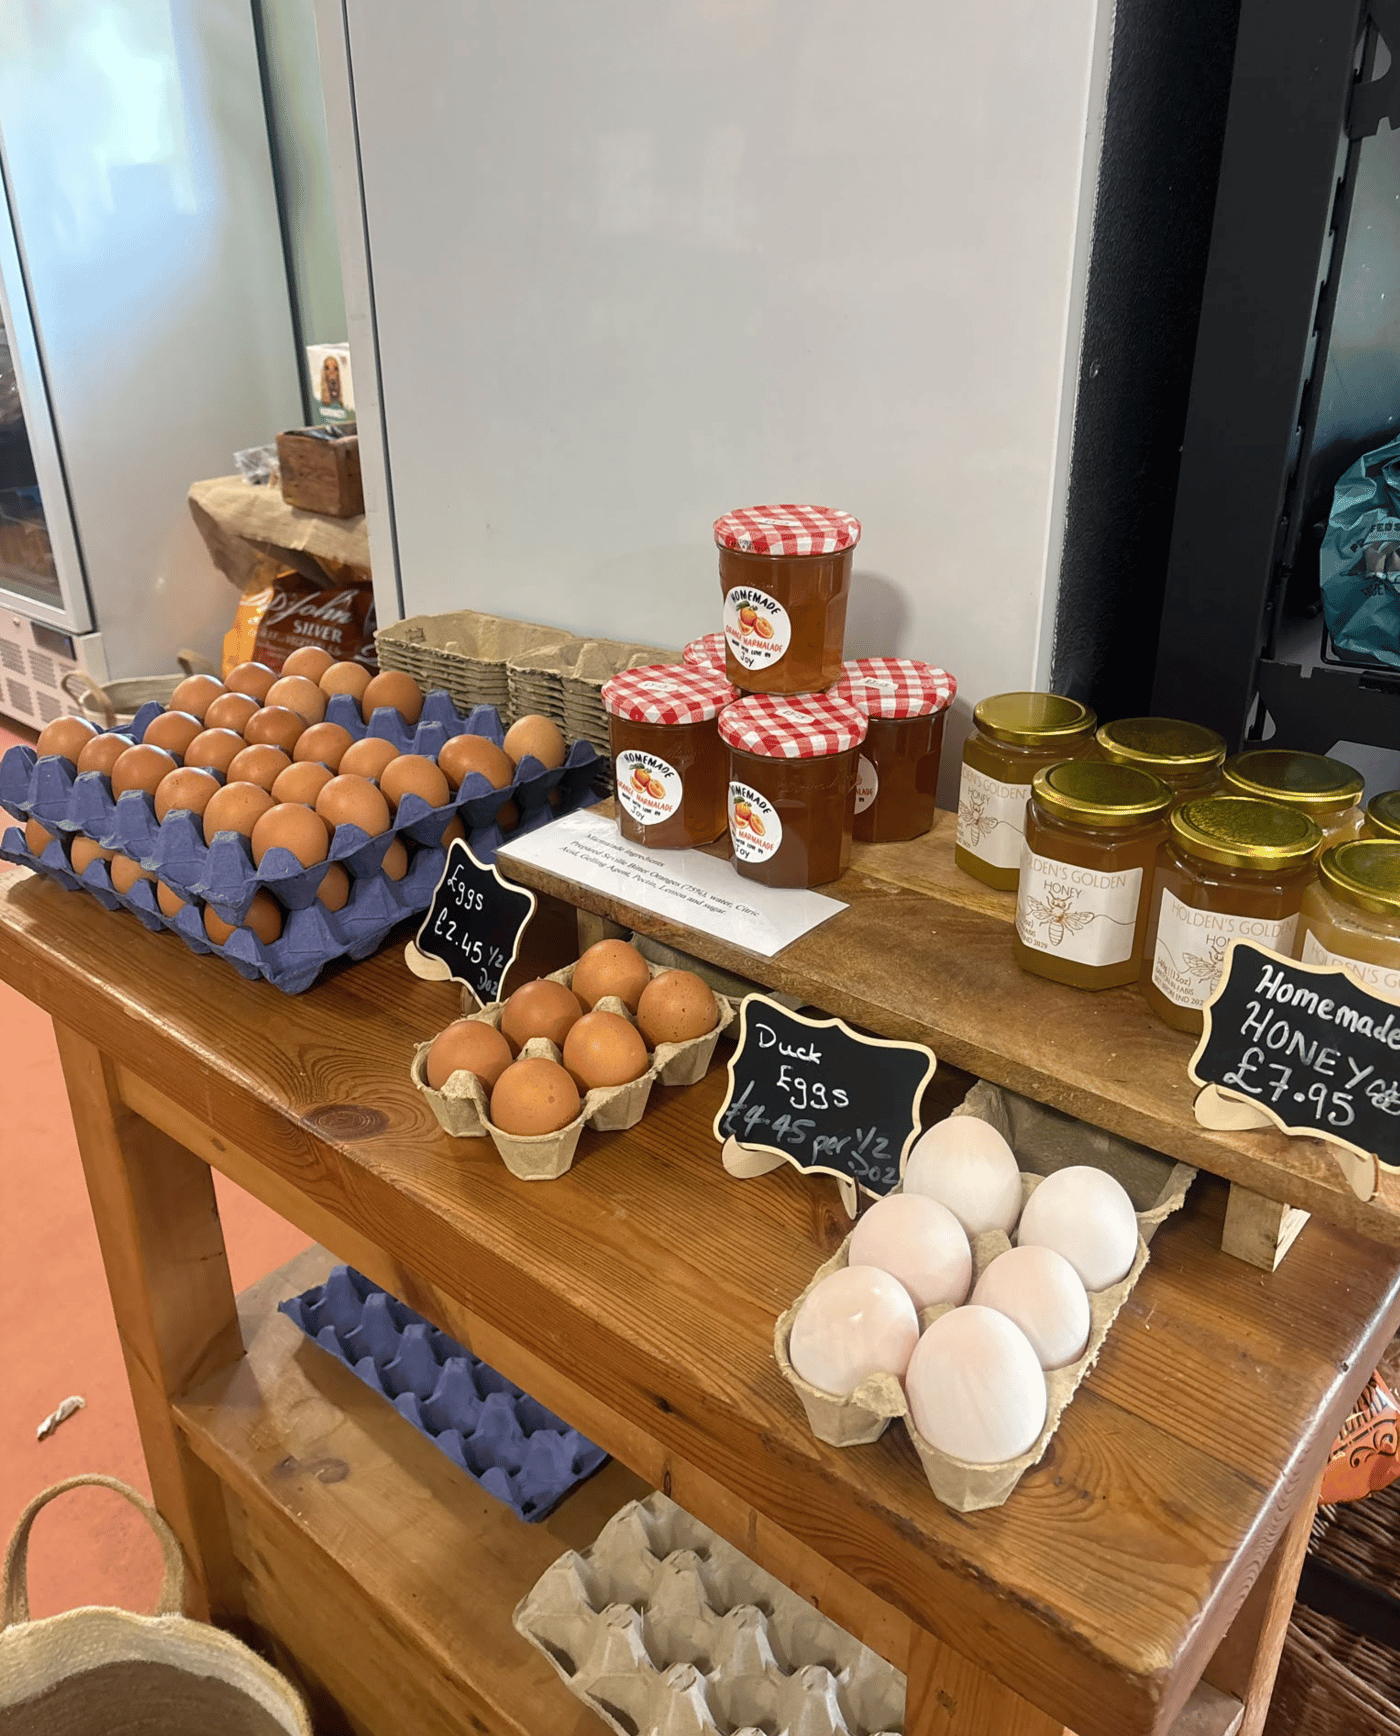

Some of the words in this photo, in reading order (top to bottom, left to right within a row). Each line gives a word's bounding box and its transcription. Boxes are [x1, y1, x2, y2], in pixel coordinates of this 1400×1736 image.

[730, 590, 781, 615] HOMEMADE
[293, 619, 343, 643] SILVER
[742, 637, 783, 653] MARMALADE
[624, 753, 675, 779] HOMEMADE
[983, 780, 1027, 800] GOLDEN
[636, 794, 674, 812] MARMALADE
[586, 833, 625, 852] Marmalade
[738, 830, 774, 851] MARMALADE
[447, 864, 484, 911] Eggs
[580, 853, 608, 868] Gelling
[659, 884, 687, 899] Lemon
[686, 896, 704, 906] and
[602, 852, 628, 866] Seville
[627, 862, 650, 874] Bitter
[649, 871, 681, 887] Oranges
[735, 904, 760, 917] Citric
[1043, 879, 1082, 899] HONEY
[1071, 870, 1127, 889] GOLDEN
[1171, 901, 1235, 933] HOLDEN'S
[1239, 920, 1293, 938] GOLDEN
[434, 907, 483, 964] £2.45
[1206, 934, 1230, 948] HO
[1170, 970, 1192, 987] (12oz)
[1384, 973, 1400, 989] G
[1191, 997, 1204, 1007] 202
[1255, 964, 1400, 1050] Homemade
[755, 1023, 822, 1064] Duck
[1240, 1000, 1375, 1089] HONEY
[776, 1065, 849, 1110] Eggs
[1222, 1047, 1356, 1127] £7.95
[812, 1135, 852, 1165] per
